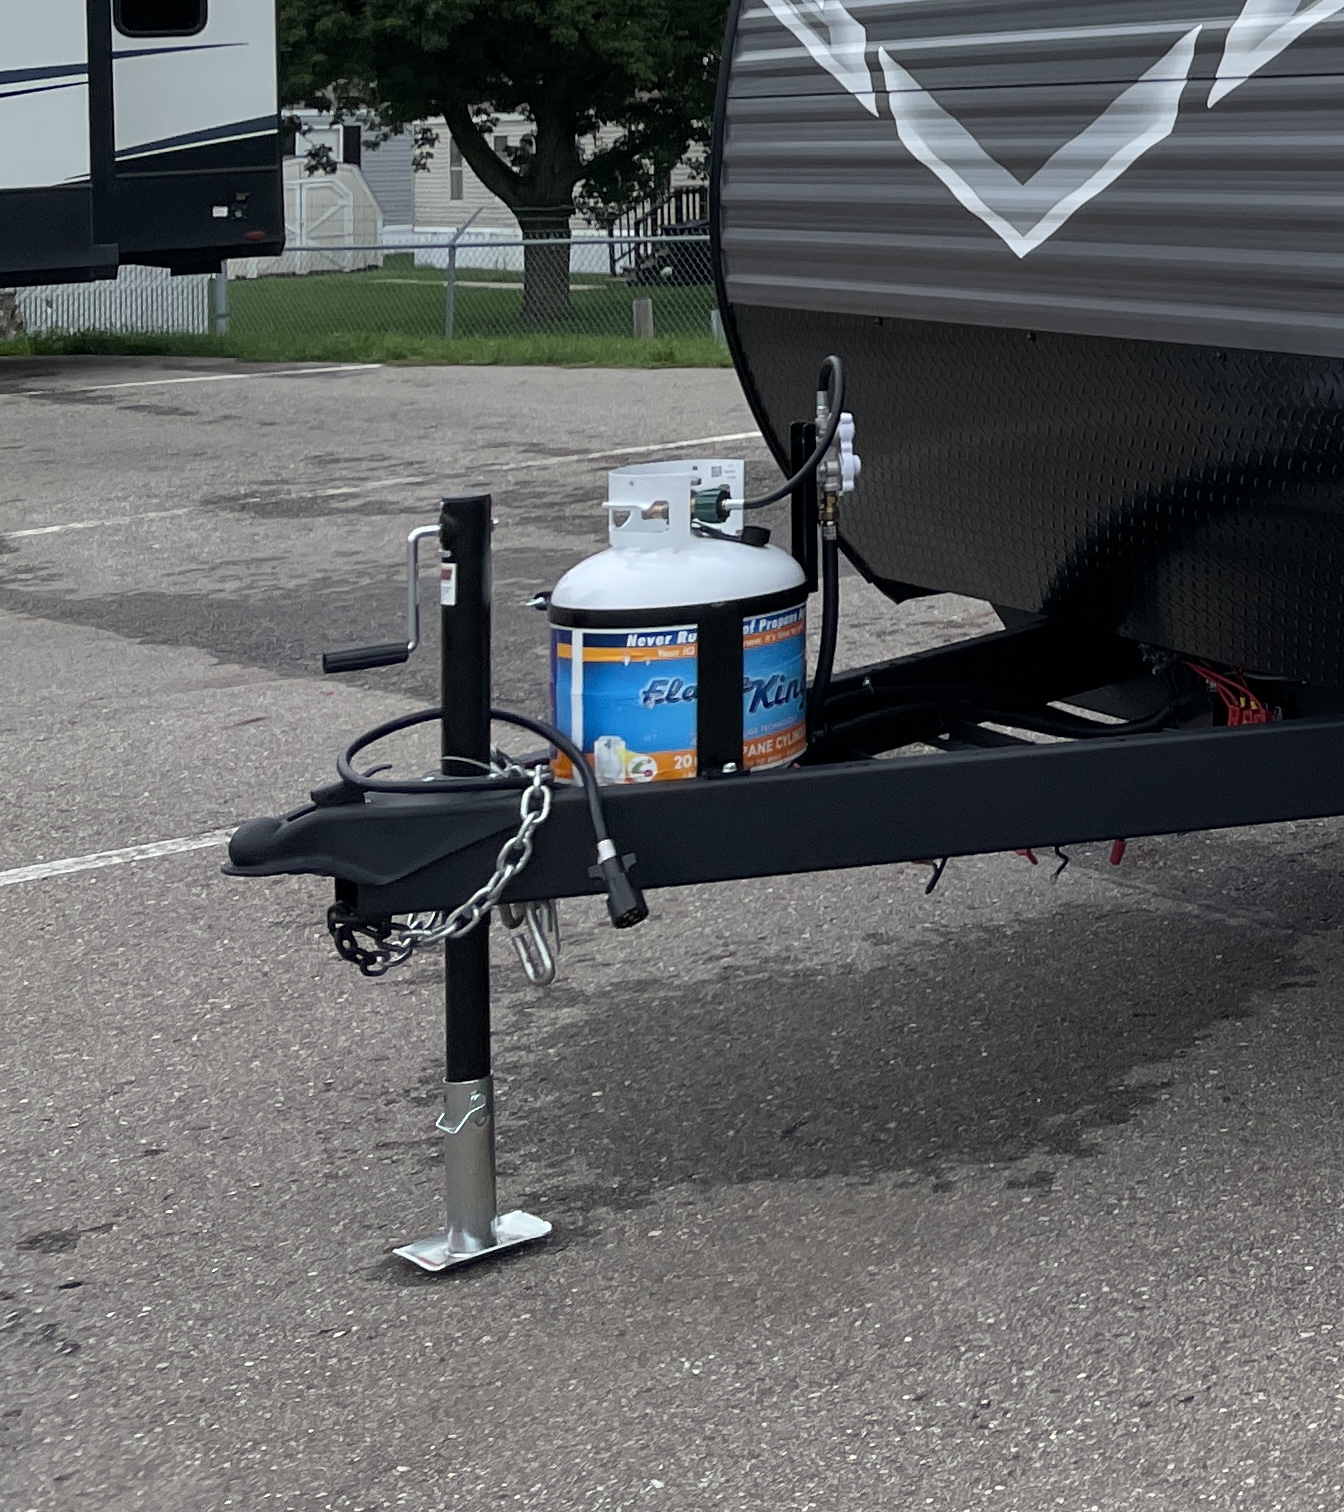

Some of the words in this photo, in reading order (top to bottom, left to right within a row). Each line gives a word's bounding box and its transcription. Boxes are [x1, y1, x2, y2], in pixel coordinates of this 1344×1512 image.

[626, 633, 672, 647] Never
[677, 630, 698, 644] Ru
[743, 619, 755, 635] of
[673, 753, 693, 770] 20
